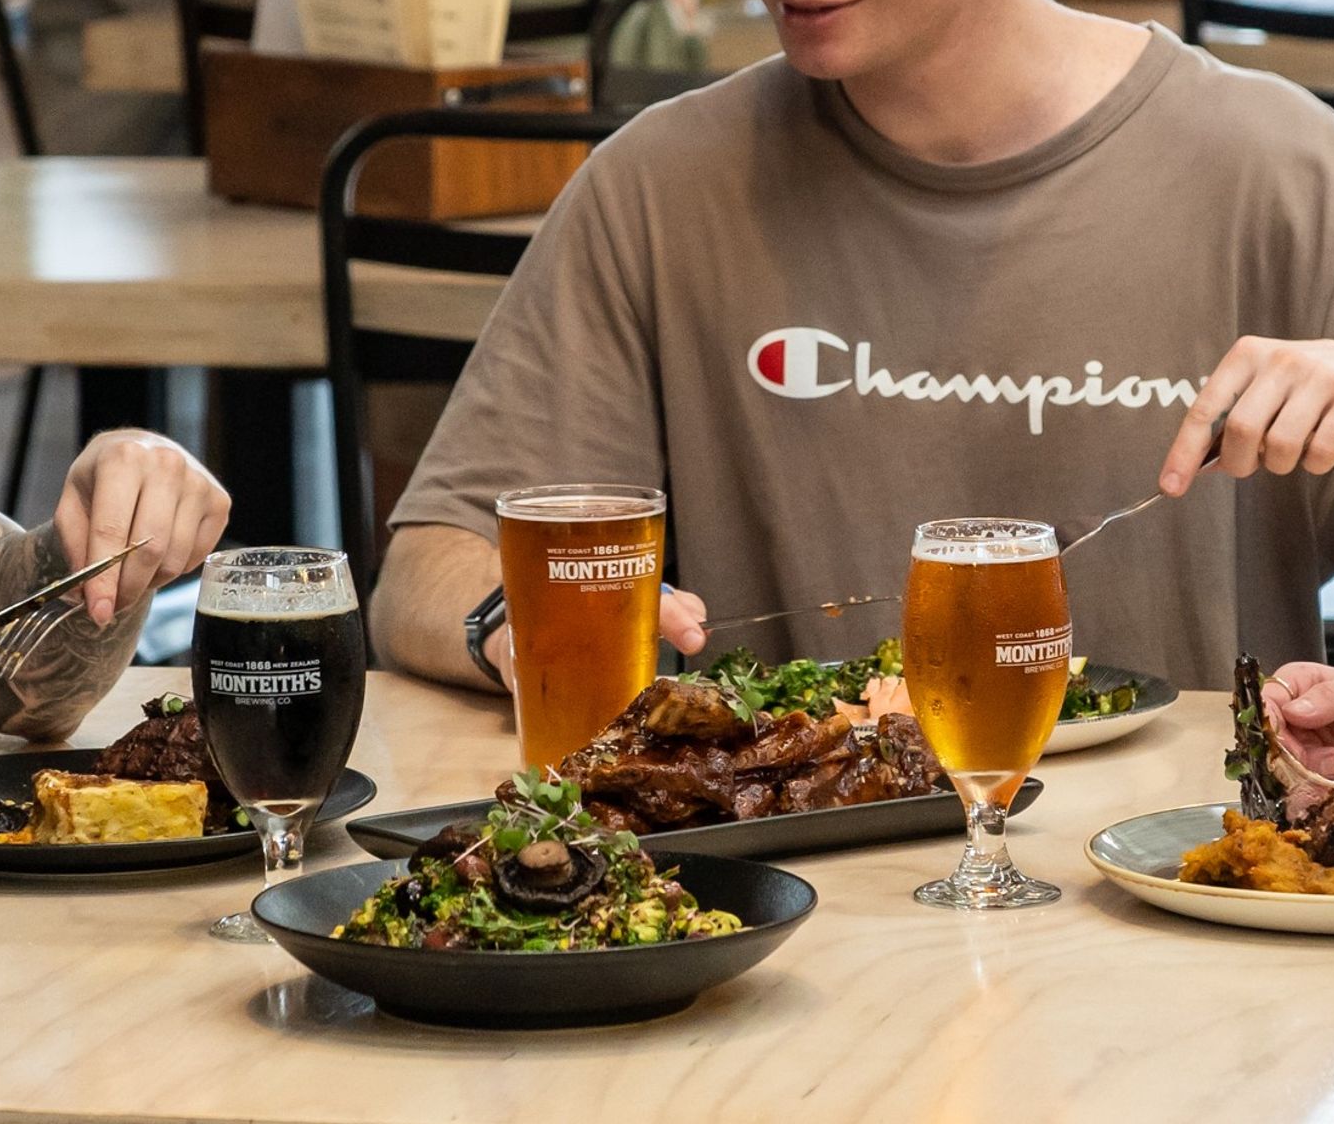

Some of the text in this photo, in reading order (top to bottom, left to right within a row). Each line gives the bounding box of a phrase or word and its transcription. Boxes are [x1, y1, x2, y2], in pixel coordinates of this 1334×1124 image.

[747, 327, 1208, 435] Champion
[593, 545, 620, 555] 1868
[548, 554, 656, 580] MONTEITH'S
[580, 583, 621, 592] BREWING
[246, 661, 271, 670] 1868
[290, 659, 320, 668] ZEALAND
[210, 671, 322, 693] MONTEITH'S
[235, 697, 274, 705] BREWING
